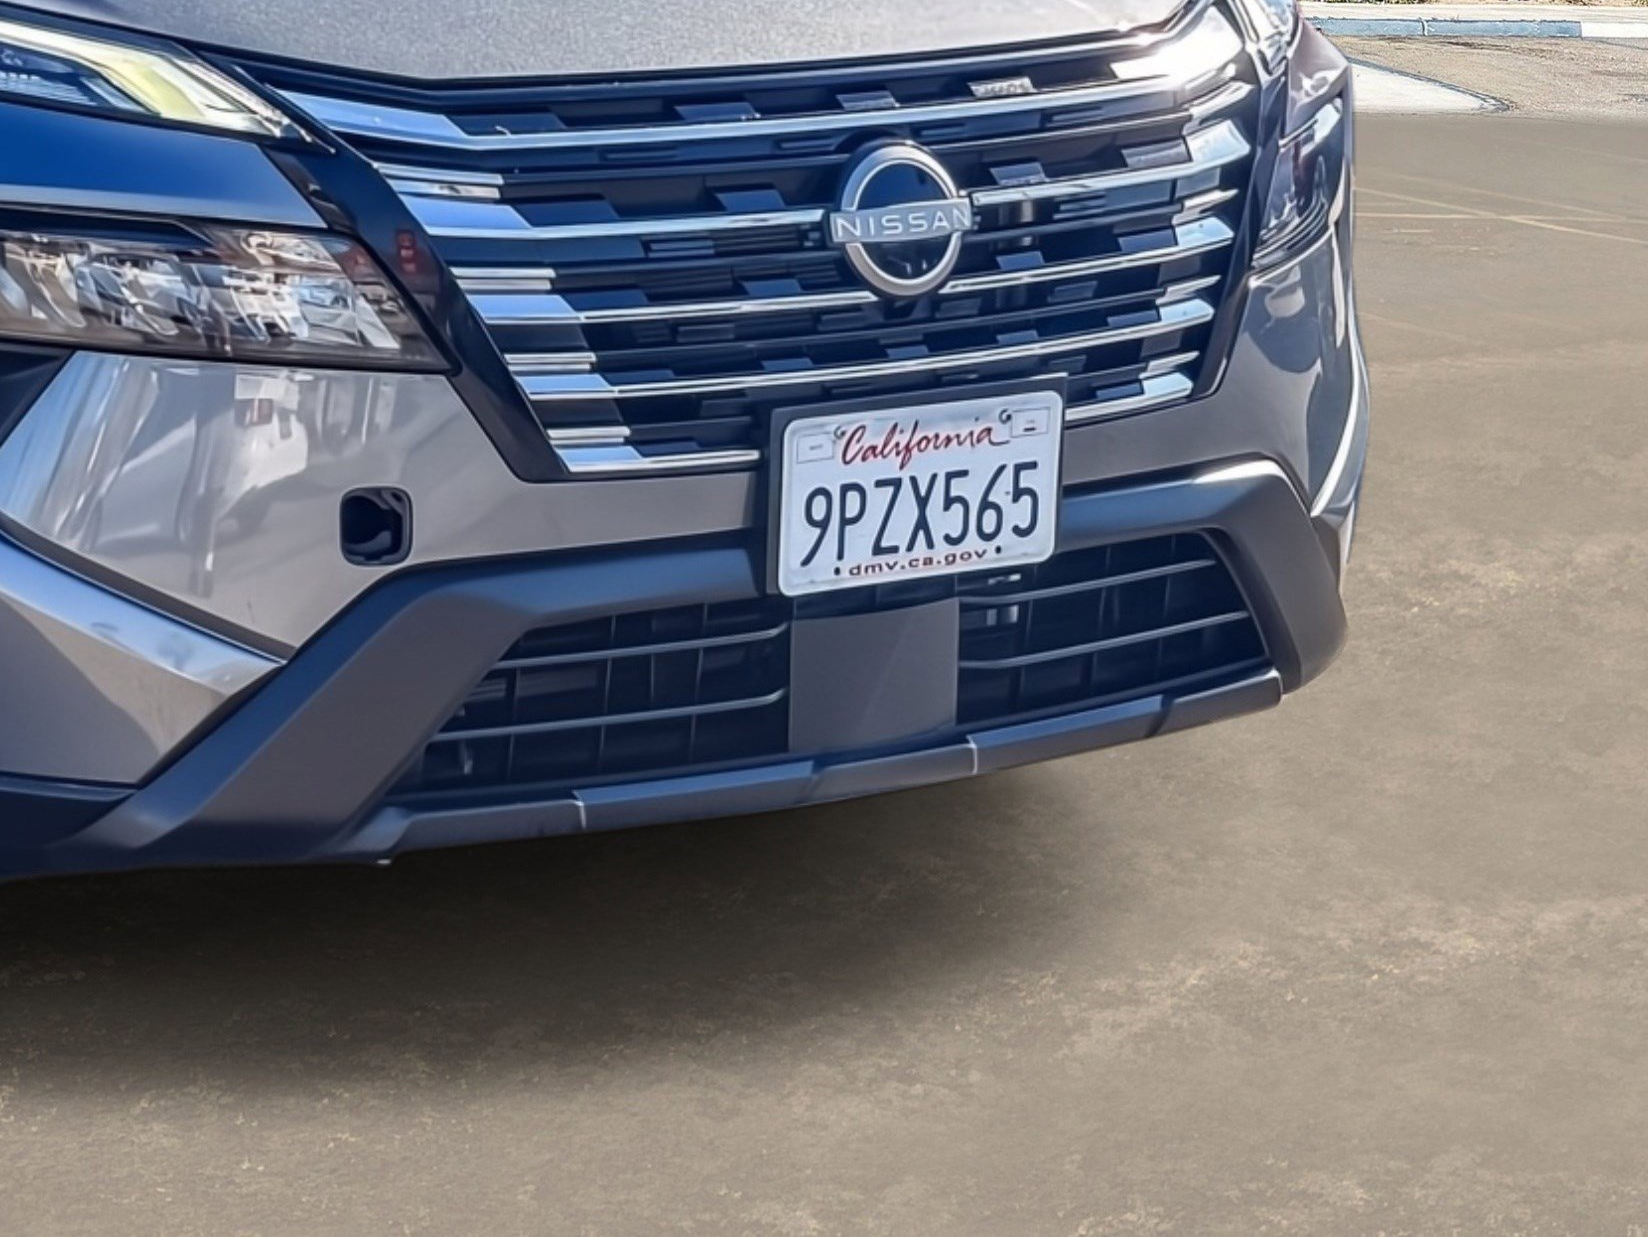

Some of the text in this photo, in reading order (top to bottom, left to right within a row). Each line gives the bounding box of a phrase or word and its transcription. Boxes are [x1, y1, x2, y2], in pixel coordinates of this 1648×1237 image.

[835, 208, 970, 239] NISSAN
[841, 417, 1010, 470] California
[800, 460, 1040, 568] 9PZX565
[848, 548, 988, 577] dmv.ca.gov
